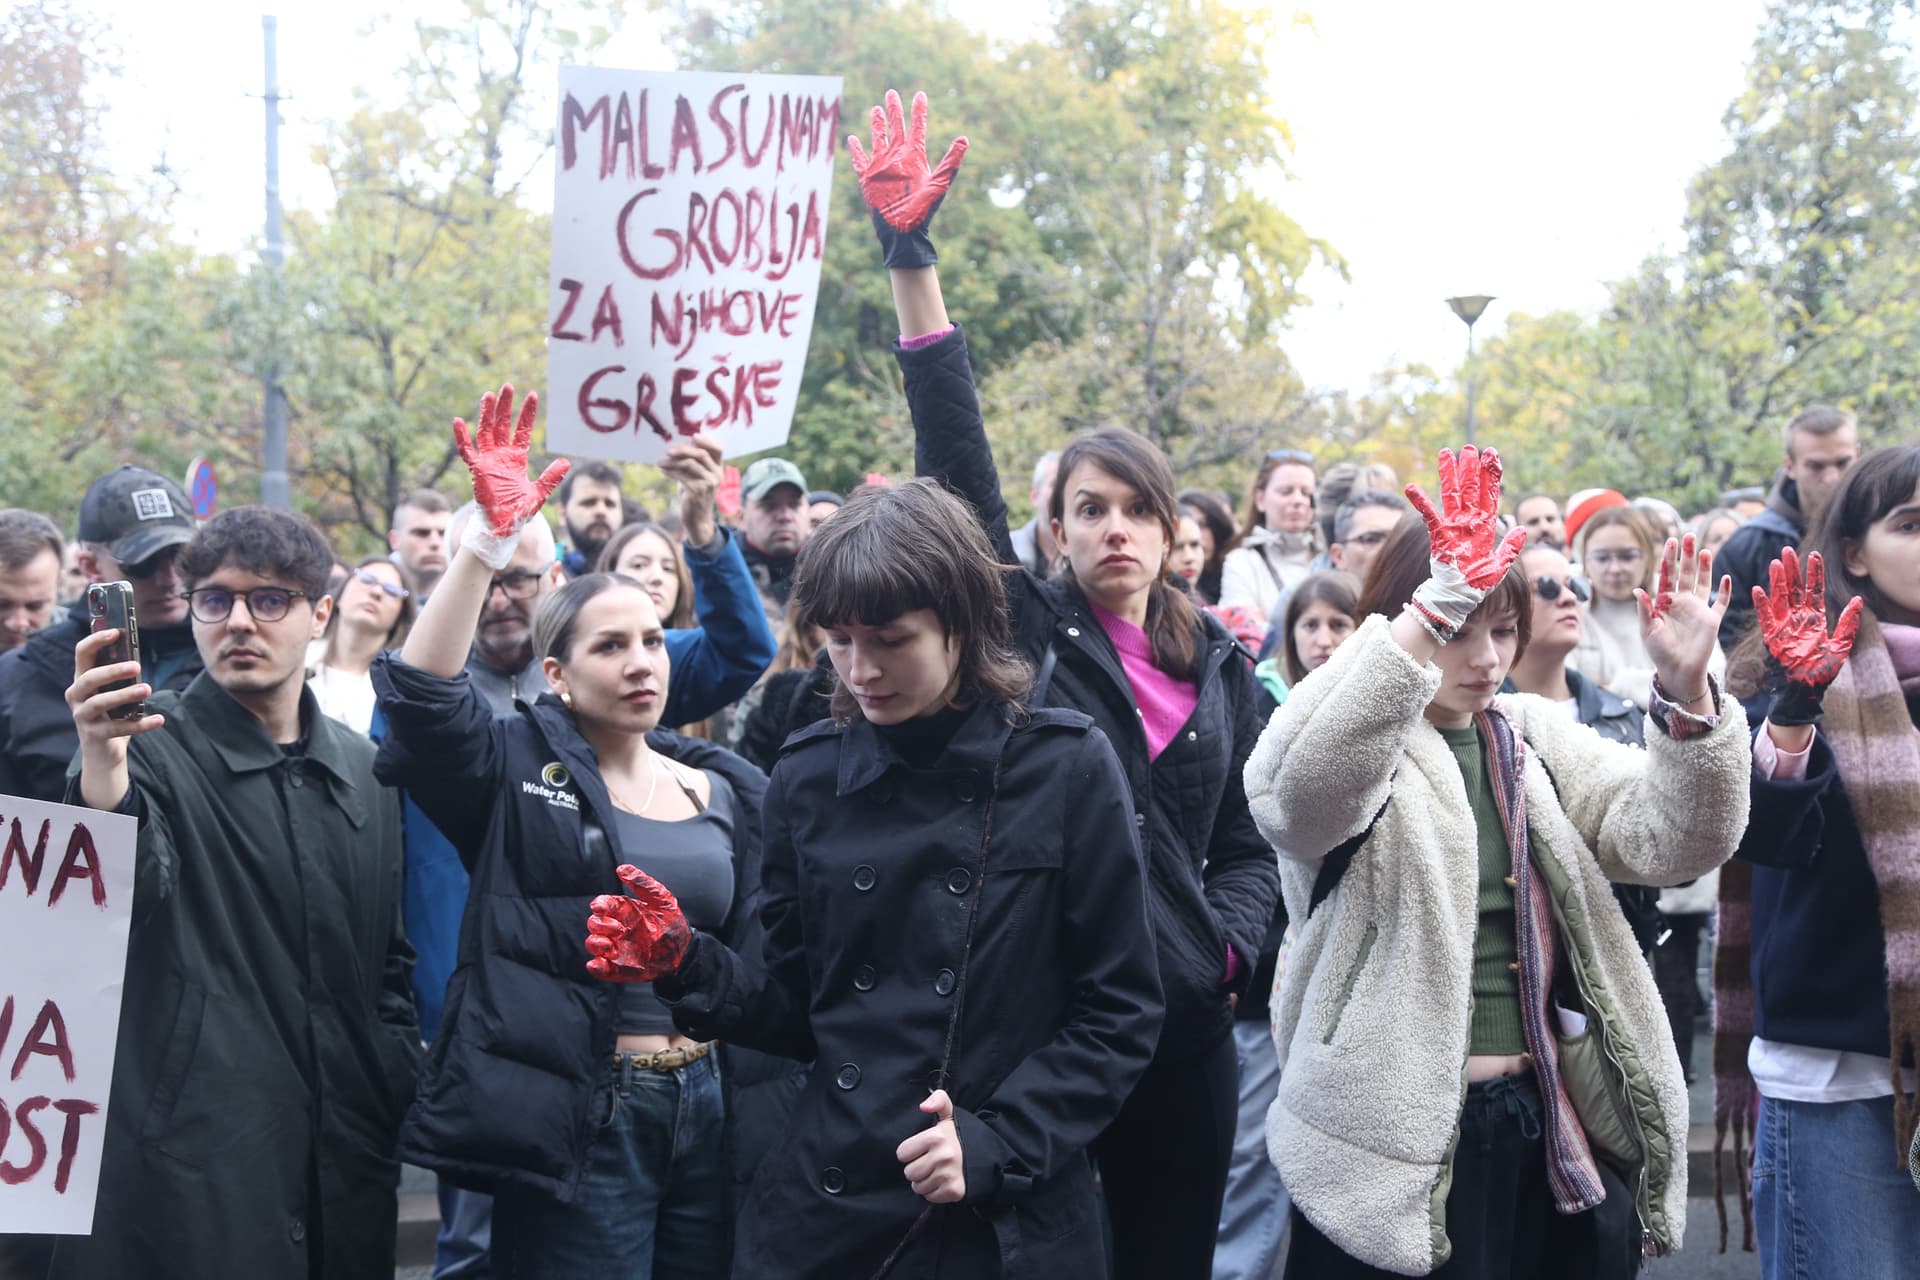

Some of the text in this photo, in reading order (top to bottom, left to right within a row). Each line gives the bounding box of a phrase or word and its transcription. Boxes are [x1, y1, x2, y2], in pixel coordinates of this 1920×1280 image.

[552, 279, 623, 347] ZA
[577, 353, 783, 441] GREŠKE
[523, 781, 556, 798] Water
[0, 815, 107, 910] NA
[0, 995, 75, 1082] A
